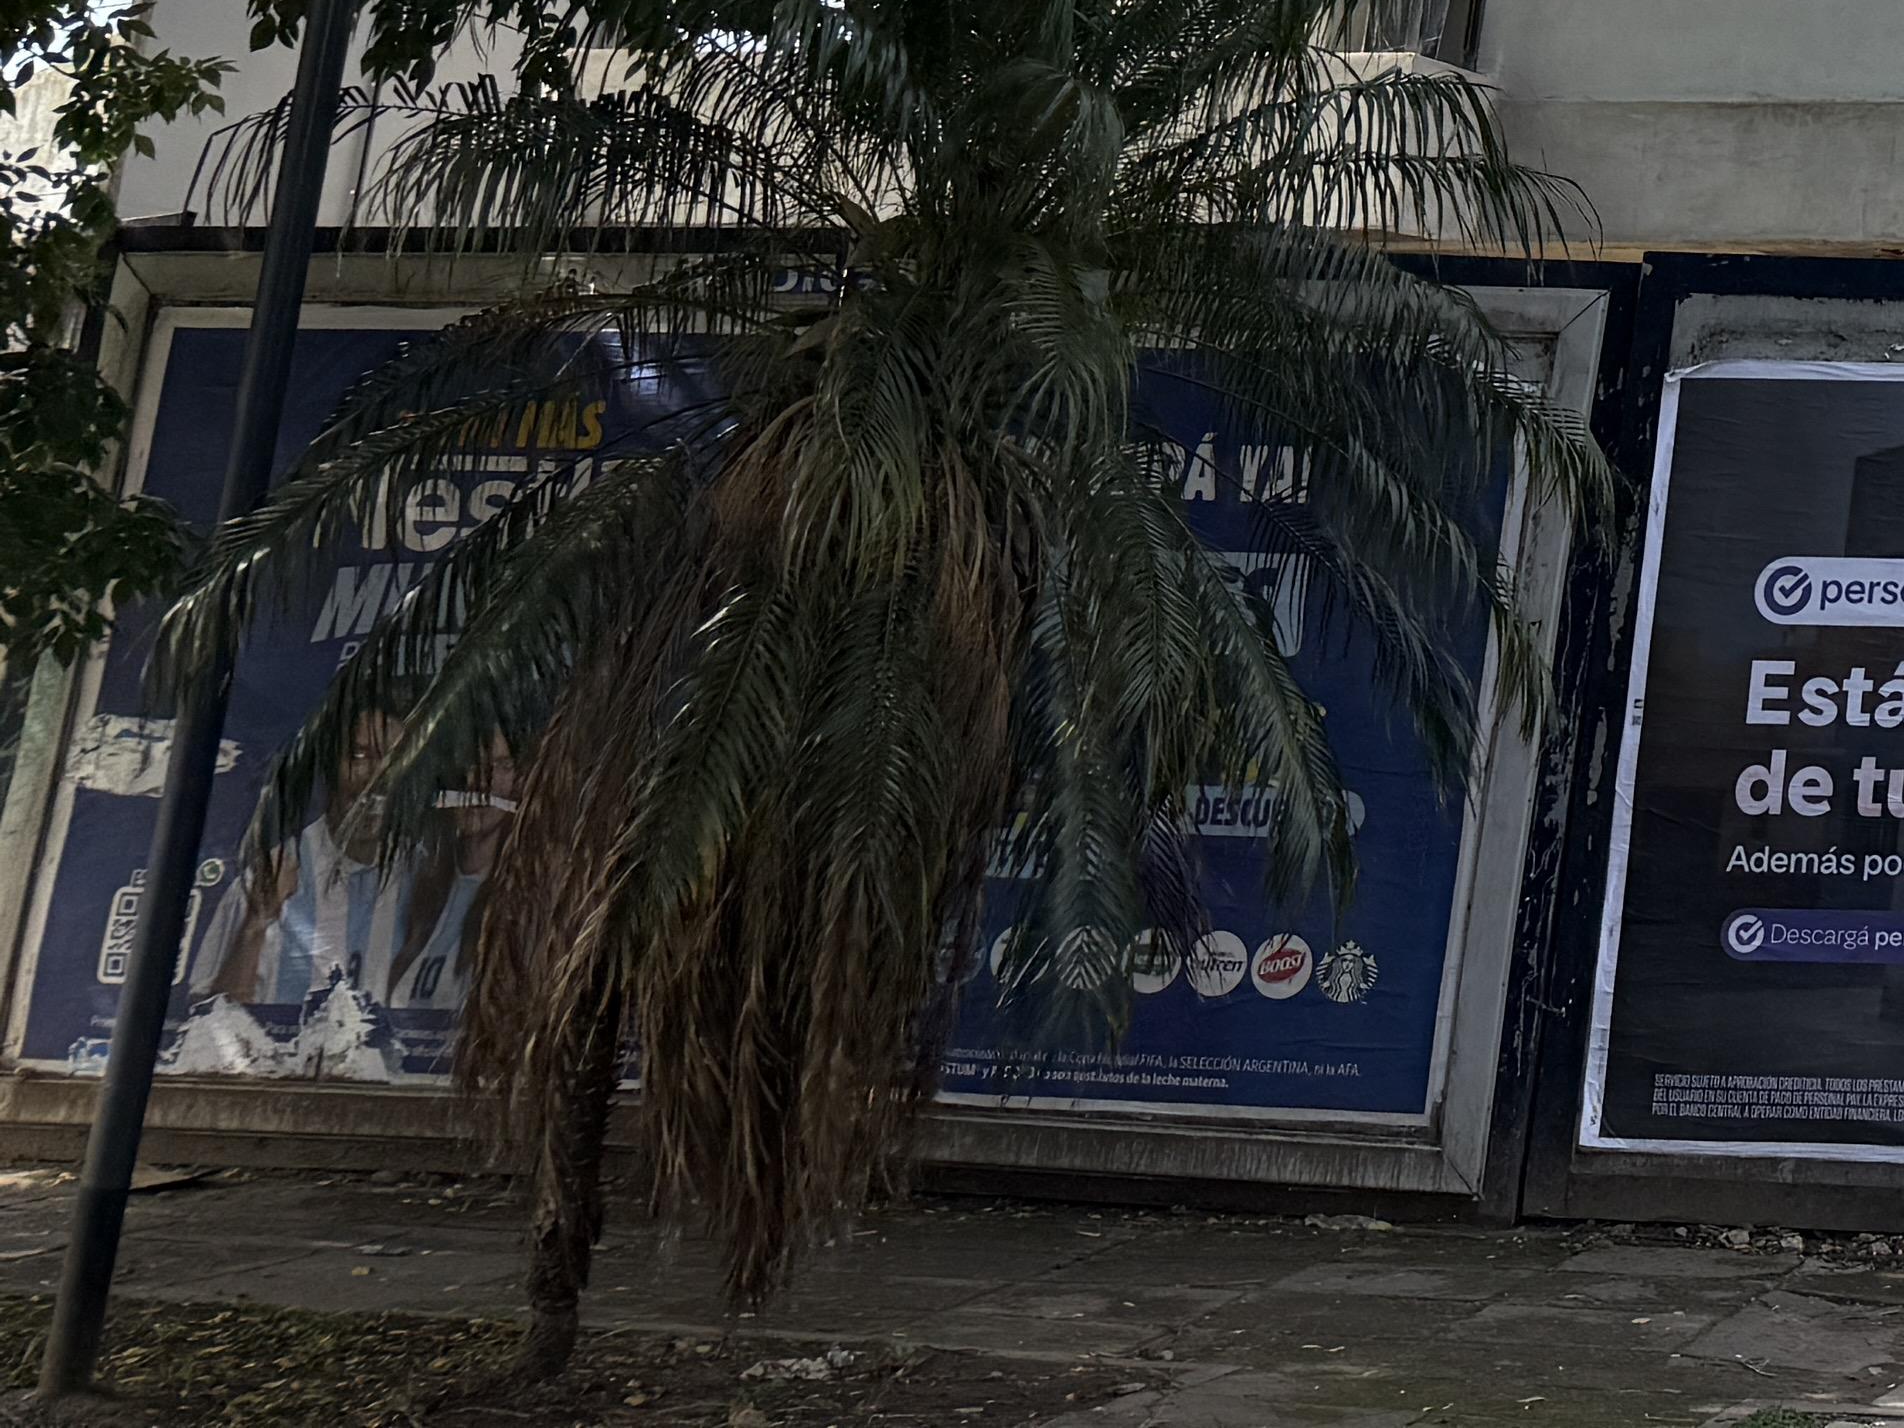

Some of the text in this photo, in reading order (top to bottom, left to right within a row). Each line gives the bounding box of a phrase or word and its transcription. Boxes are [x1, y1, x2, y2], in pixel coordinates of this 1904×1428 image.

[1734, 749, 1834, 817] de
[1725, 844, 1856, 876] Además
[1770, 922, 1870, 950] Descargá
[1258, 952, 1304, 976] BOOST
[1179, 1055, 1241, 1072] SELECCIÓN
[1242, 1058, 1313, 1076] ARGENTINA,
